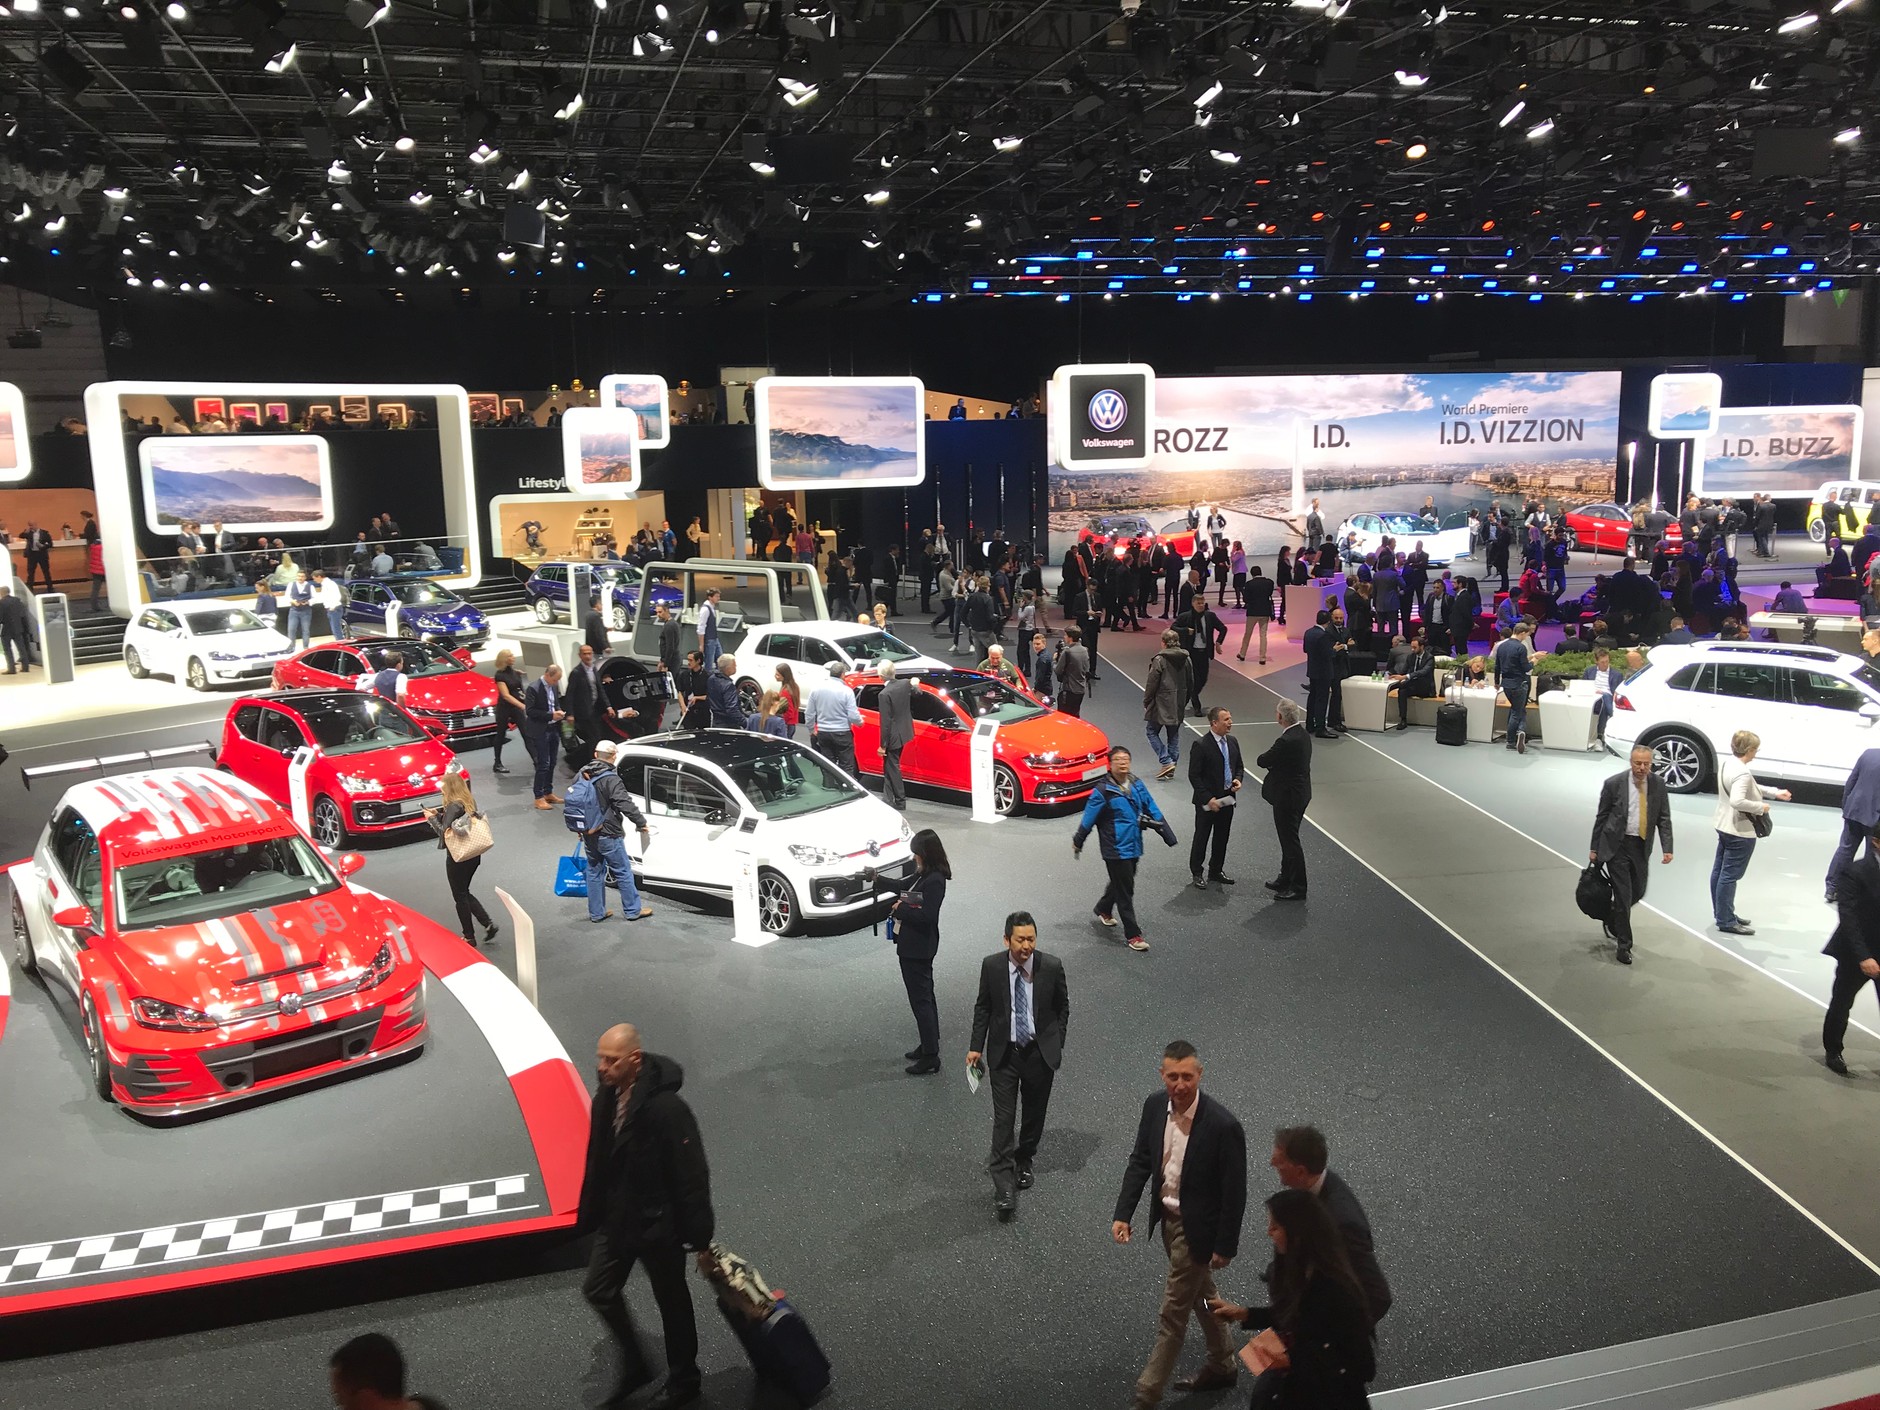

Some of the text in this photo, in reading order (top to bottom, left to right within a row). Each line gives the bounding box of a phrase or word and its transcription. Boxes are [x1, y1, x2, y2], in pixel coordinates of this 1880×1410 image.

[1441, 403, 1529, 416] World Premiere
[1154, 427, 1229, 454] ROZZ
[1313, 424, 1351, 448] I.D.
[1440, 418, 1584, 444] I.D. VIZZION
[1082, 438, 1134, 449] Volkswagen
[1722, 437, 1836, 457] I.D. BUZZ
[121, 824, 285, 859] Volkswagen Motorsport
